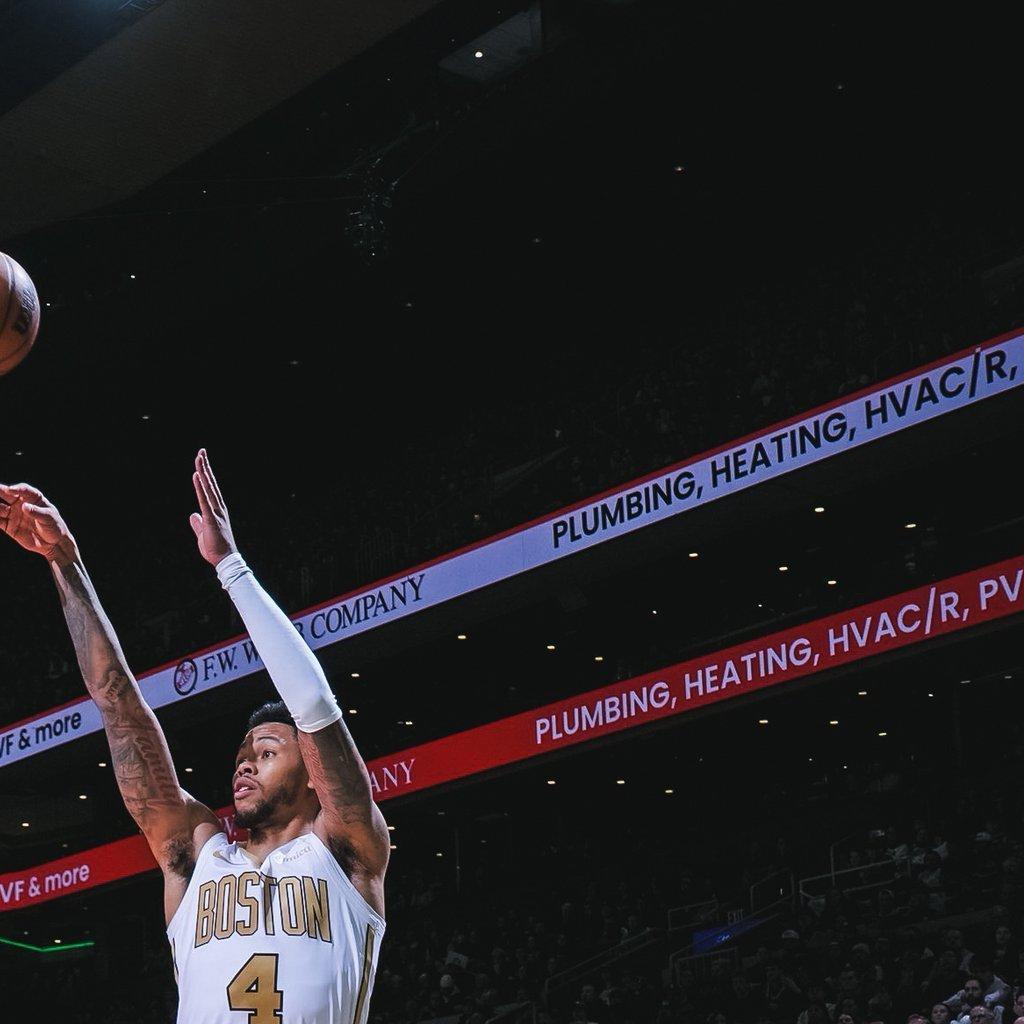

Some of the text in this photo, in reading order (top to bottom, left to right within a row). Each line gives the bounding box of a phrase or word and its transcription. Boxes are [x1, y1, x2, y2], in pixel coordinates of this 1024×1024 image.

[552, 346, 1018, 548] PLUMBING, HEATING, HVAC/R,
[202, 652, 238, 681] F.W.
[310, 574, 425, 639] COMPANY
[536, 682, 677, 744] PLUMBING,
[684, 637, 820, 700] HEATING,
[828, 586, 970, 656] HVAC/R,
[19, 727, 31, 751] &
[36, 711, 82, 745] more
[28, 875, 41, 897] &
[45, 863, 90, 892] more
[195, 871, 333, 948] BOSTON
